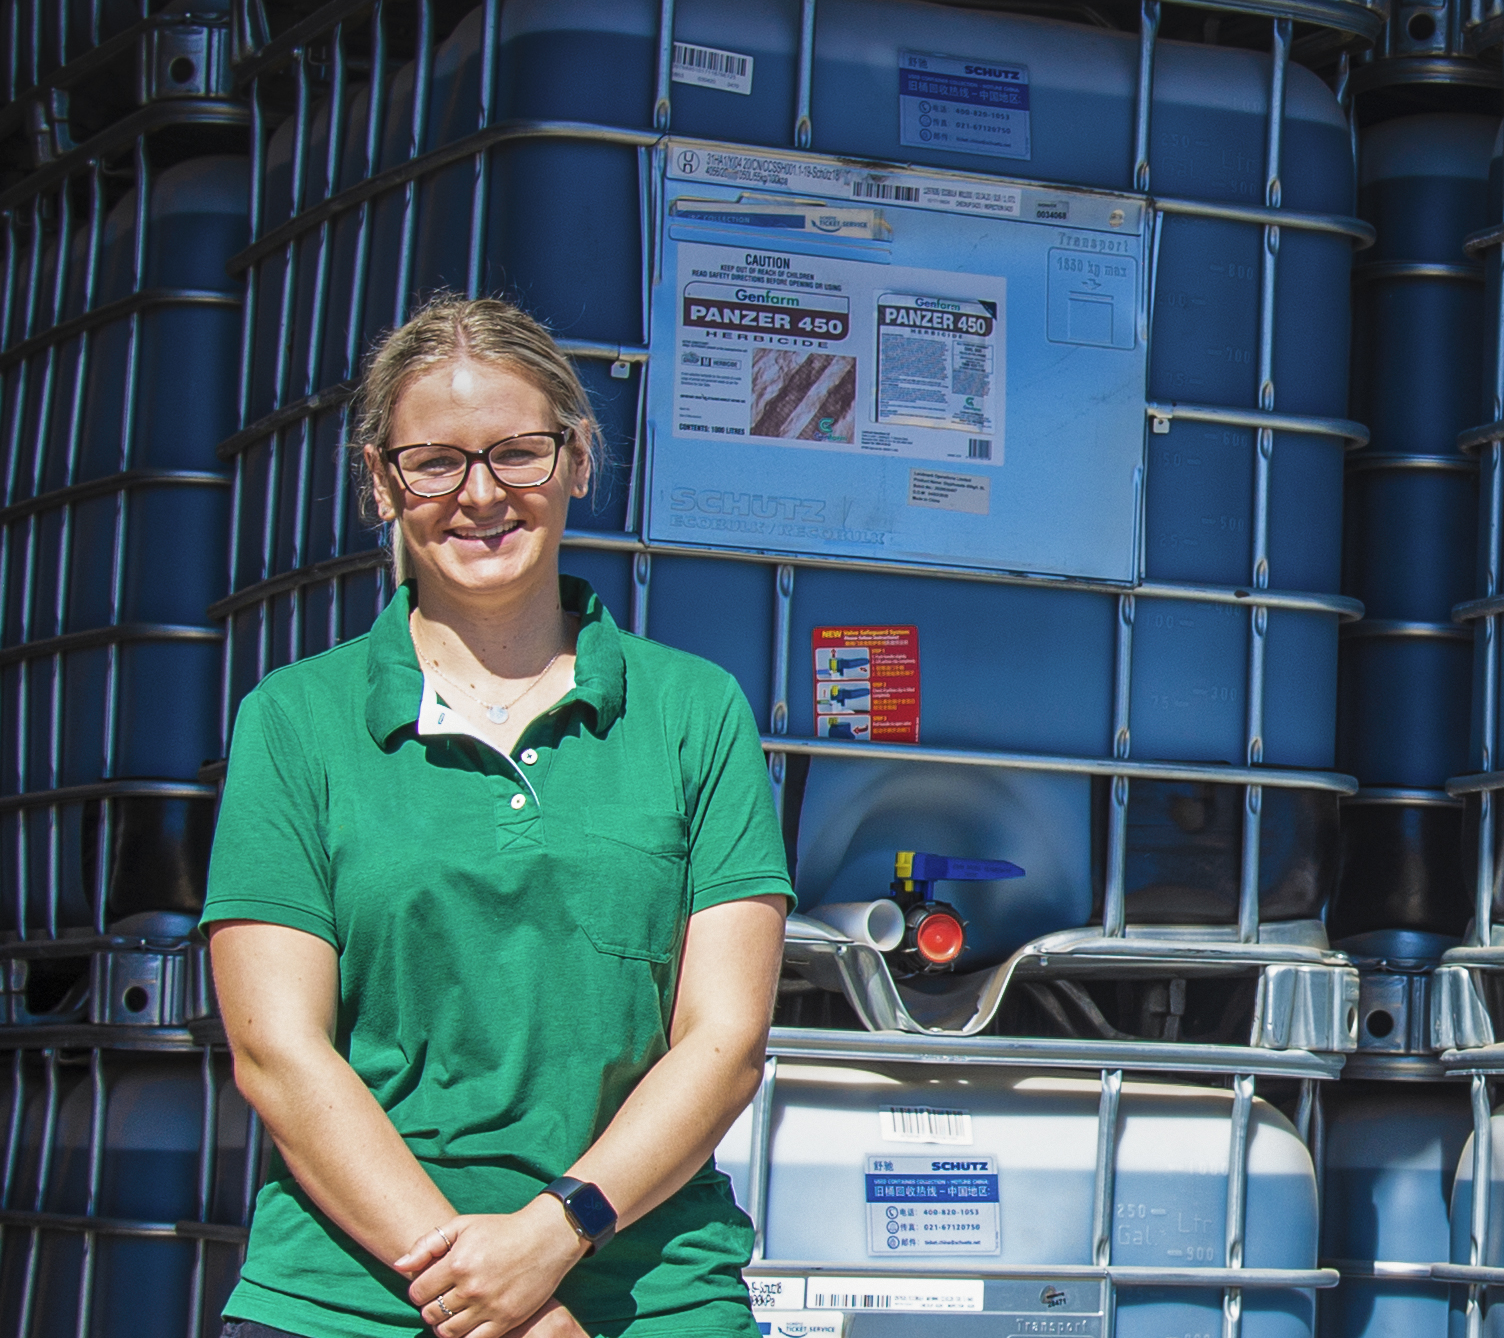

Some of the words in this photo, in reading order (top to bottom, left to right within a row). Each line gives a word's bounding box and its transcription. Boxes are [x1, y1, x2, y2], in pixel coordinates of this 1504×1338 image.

[965, 65, 1020, 80] SCHUTZ
[745, 253, 790, 270] CAUTION
[720, 264, 734, 272] KEEP
[736, 265, 747, 273] OUT
[757, 268, 777, 276] REACH
[786, 271, 815, 280] CHILDREN
[692, 269, 708, 277] READ
[709, 271, 730, 280] SAFETY
[731, 273, 765, 283] DIRECTIONS
[766, 276, 788, 286] BEFORE
[789, 279, 814, 288] OPENING
[824, 283, 842, 291] USING
[735, 288, 799, 307] Genfarm
[915, 297, 961, 311] Genfarm
[690, 304, 791, 329] PANZER
[798, 317, 843, 334] 450
[884, 308, 954, 329] PANZER
[957, 316, 986, 334] 450
[706, 330, 829, 349] HERBICIDE
[910, 328, 963, 340] HERBICIDE
[931, 1162, 989, 1171] SCHUTZ
[923, 1208, 979, 1216] 400-820-1053
[1117, 1204, 1146, 1218] 250
[923, 1223, 981, 1231] 021-67120750
[1186, 1247, 1214, 1261] 900
[809, 1325, 835, 1333] SERVICE
